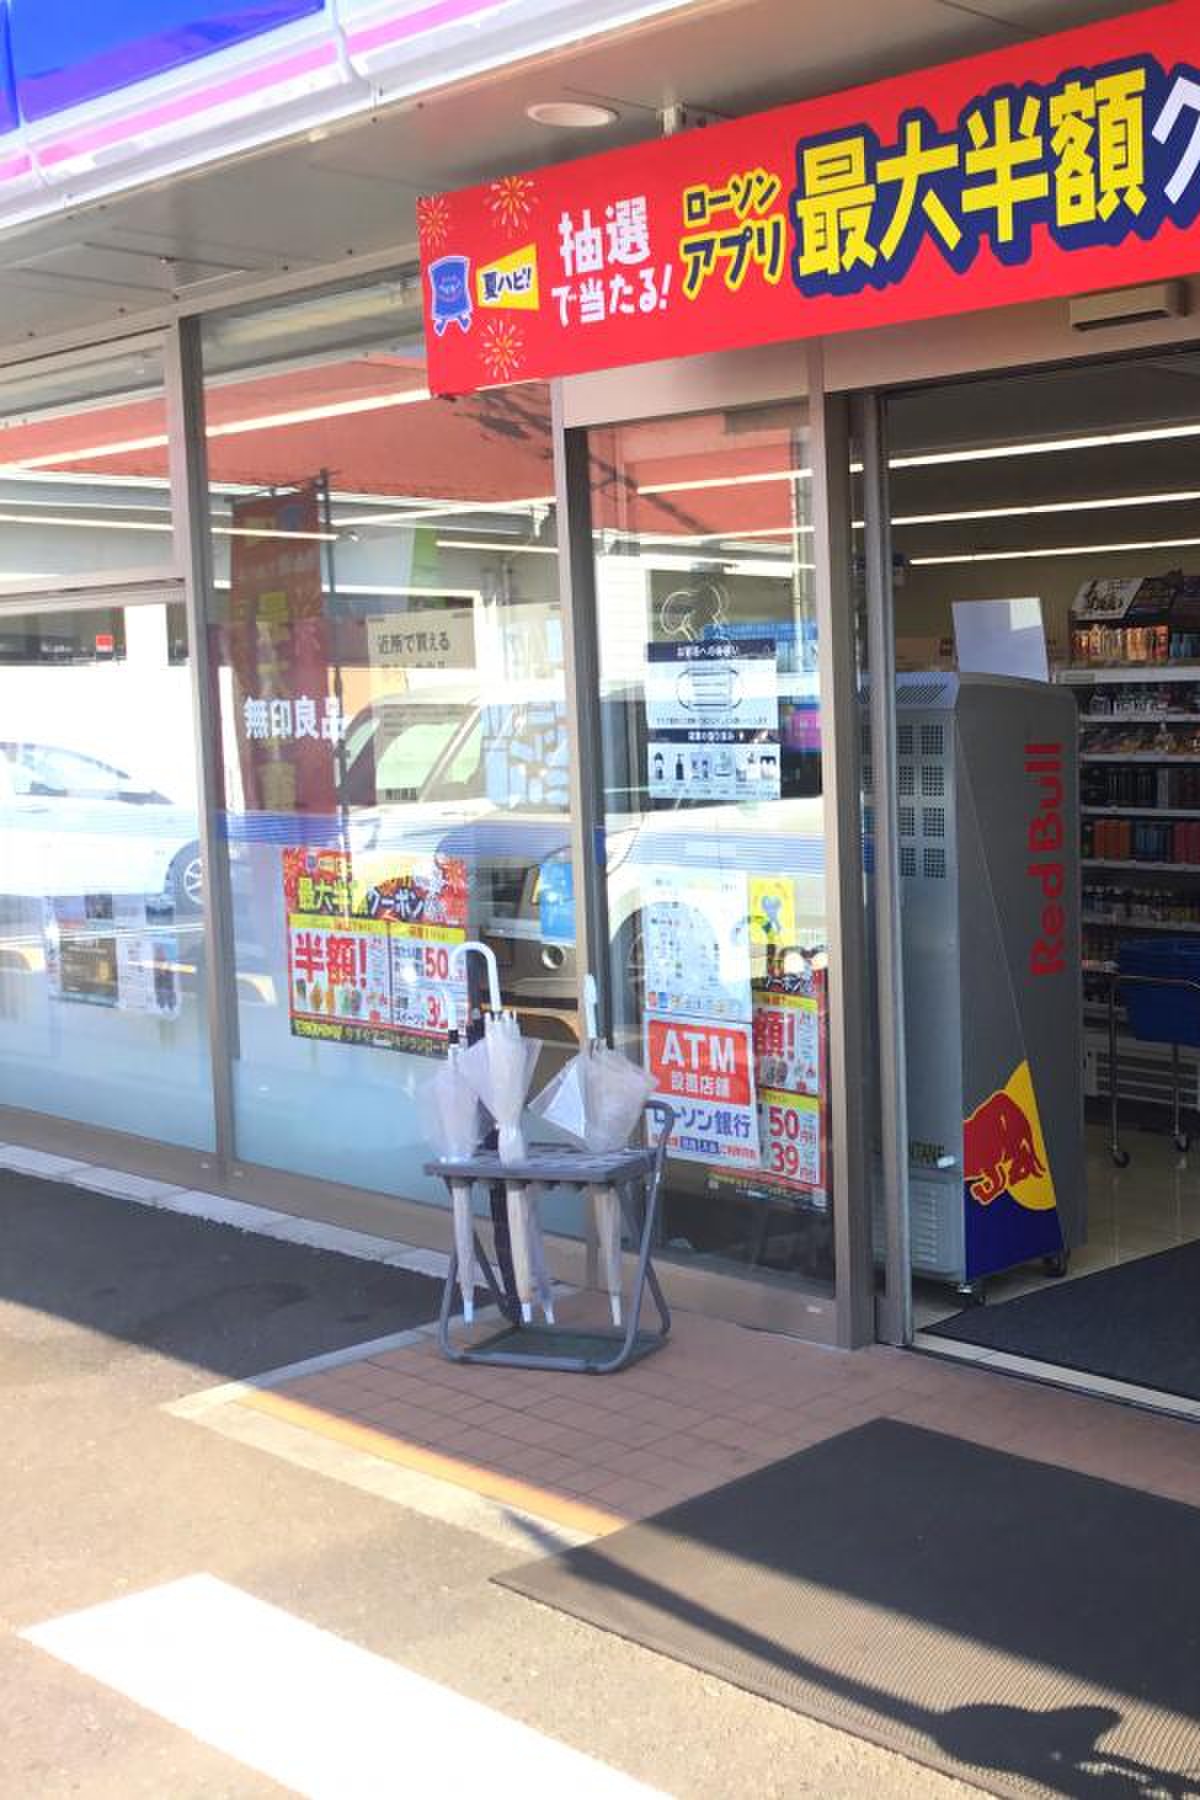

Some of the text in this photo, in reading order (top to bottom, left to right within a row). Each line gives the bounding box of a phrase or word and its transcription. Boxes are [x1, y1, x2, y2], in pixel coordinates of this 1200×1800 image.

[683, 168, 782, 225] ローソン
[558, 195, 650, 277] 抽選
[681, 214, 785, 299] アプリ
[551, 263, 673, 327] で当たる!
[244, 695, 346, 740] 無印良品
[1024, 743, 1066, 976] Red Bull
[660, 1029, 737, 1075] ATM
[768, 1105, 800, 1141] 50
[770, 1140, 800, 1178] 39
